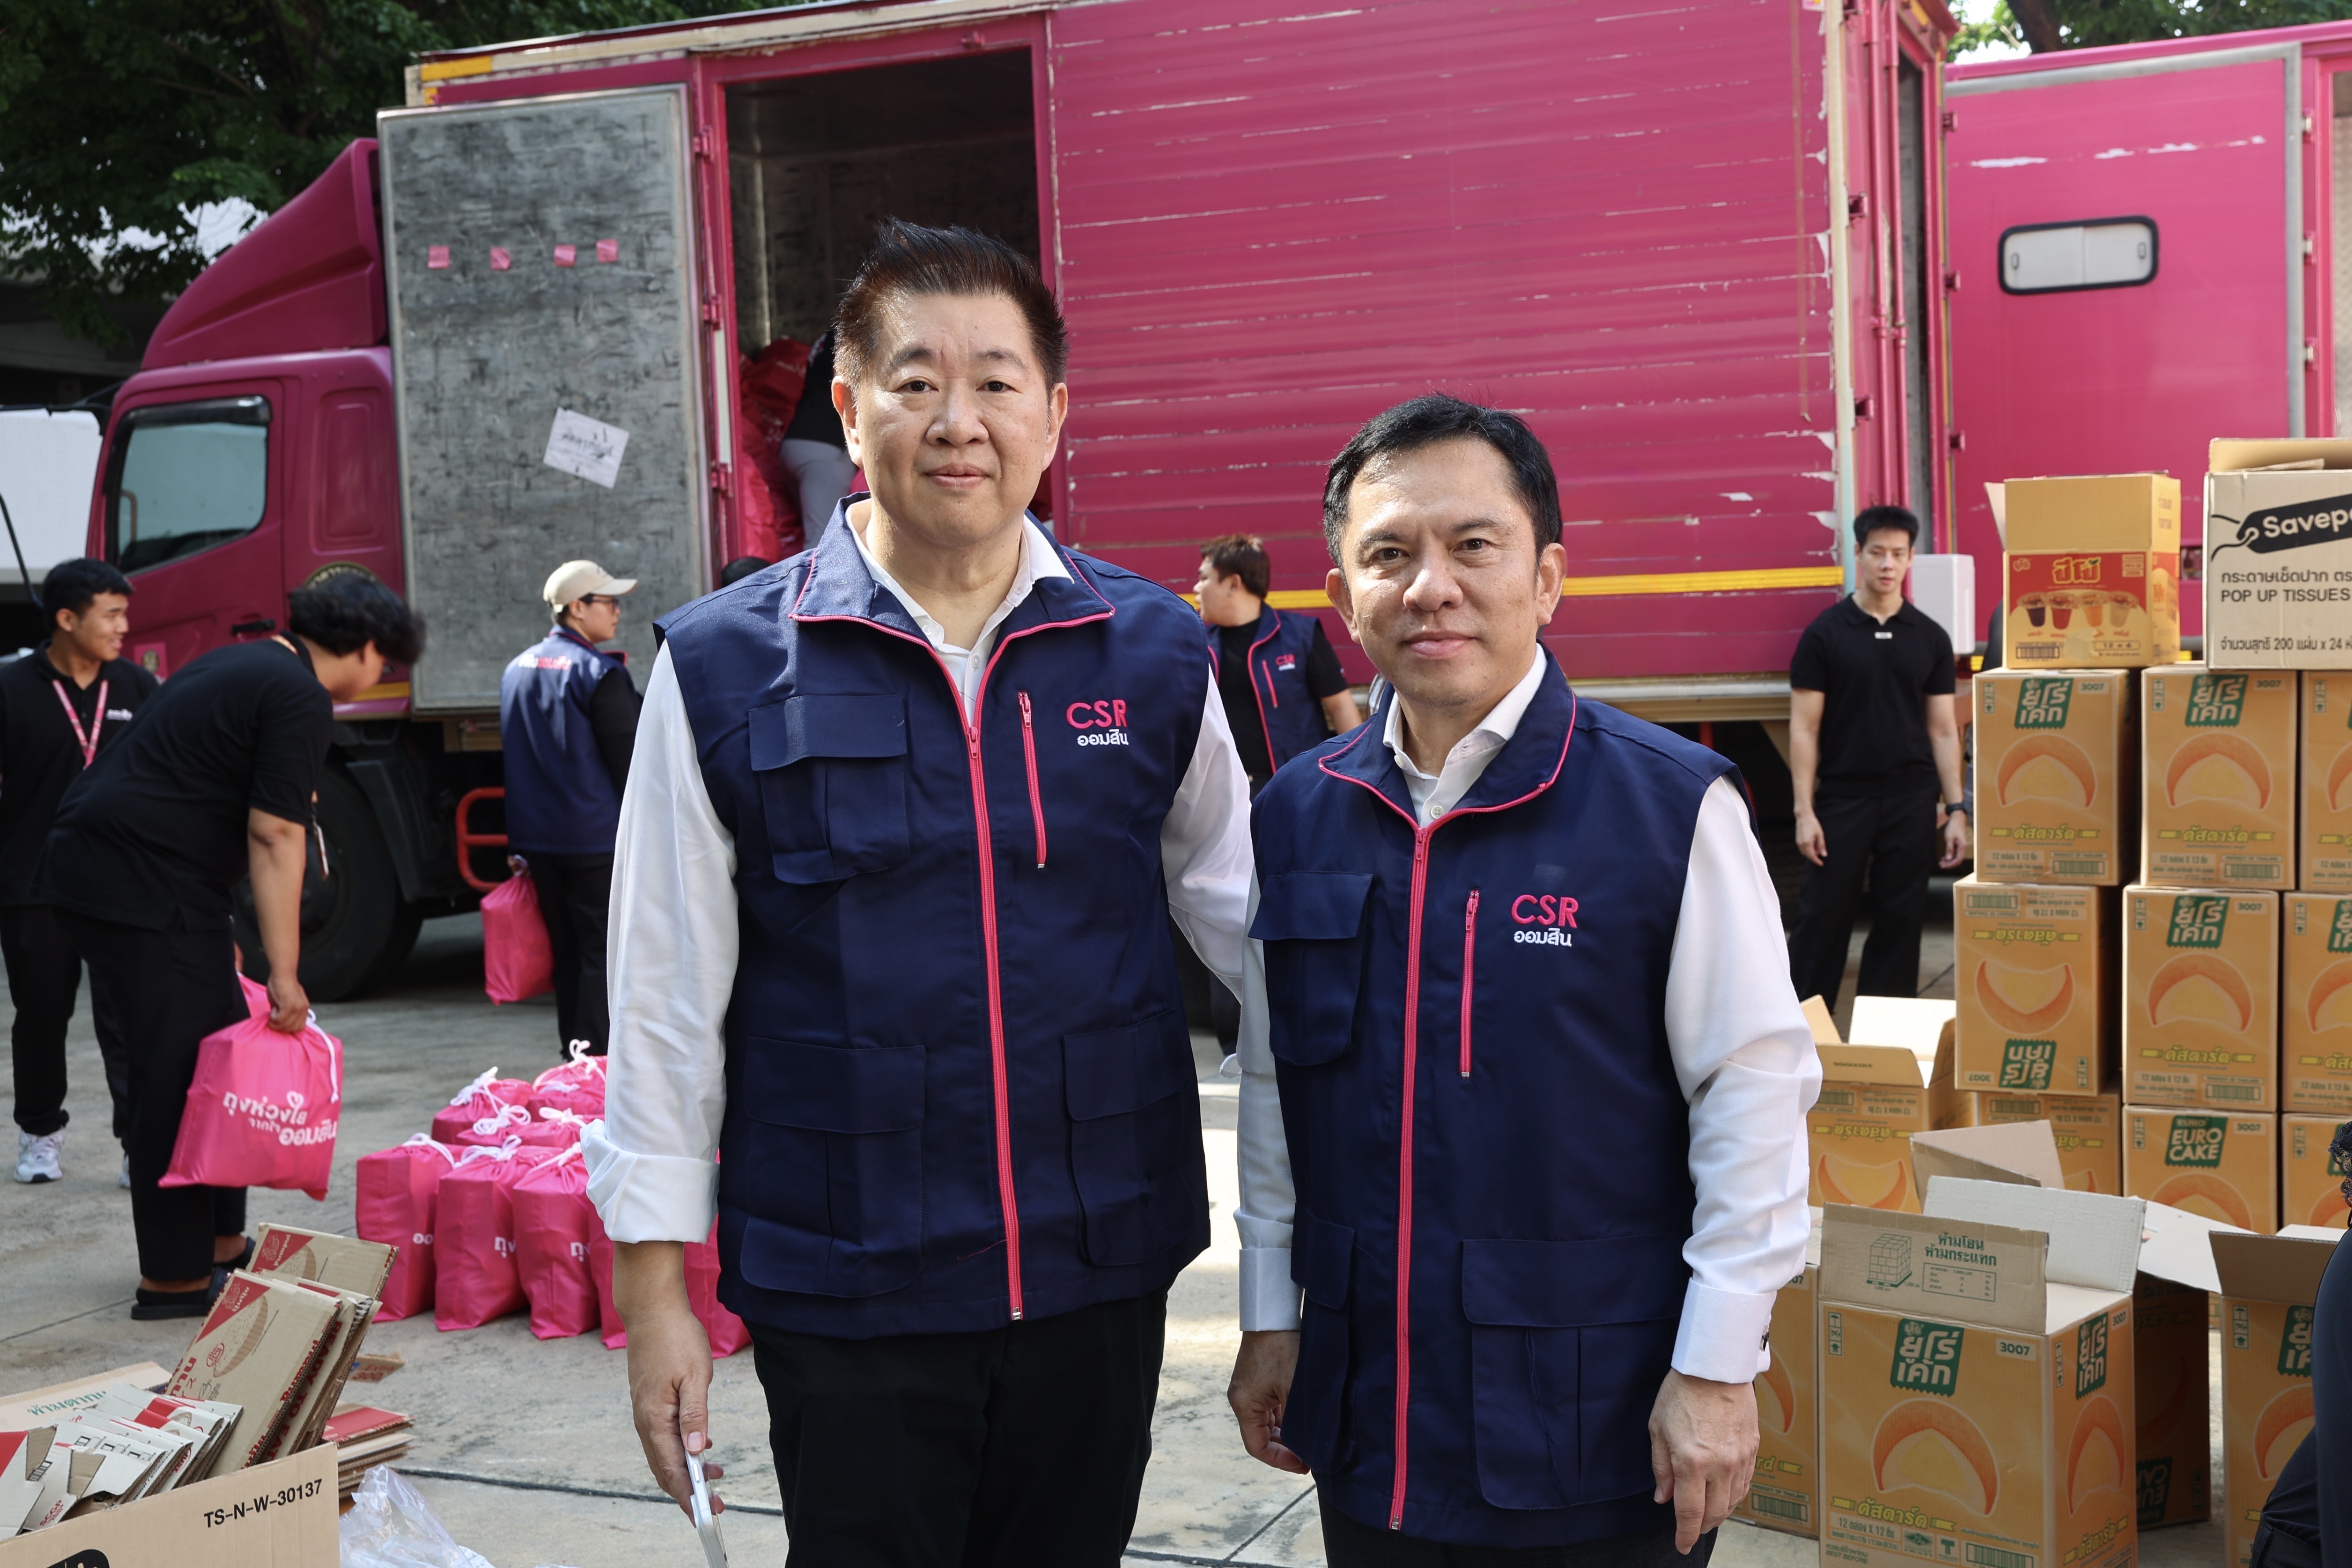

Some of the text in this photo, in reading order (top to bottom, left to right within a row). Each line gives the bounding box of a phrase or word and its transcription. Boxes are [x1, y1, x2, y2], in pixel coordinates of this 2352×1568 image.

[2262, 509, 2352, 538] Savep
[2221, 566, 2329, 583] กระดาษเช็ดปาก
[2221, 587, 2351, 602] POP UP TISSUES
[2273, 638, 2293, 650] 200
[2329, 638, 2342, 650] 24
[2081, 683, 2105, 691] 3007
[2256, 679, 2281, 688] 3007
[1065, 699, 1128, 730] CSR
[1076, 728, 1129, 747] ออมสิน
[1511, 894, 1579, 929] CSR
[2238, 902, 2263, 911] 3007
[1513, 927, 1572, 948] ออมสิน
[2171, 1127, 2223, 1145] EURO
[2236, 1123, 2262, 1132] 3007
[2168, 1143, 2220, 1162] CAKE
[1937, 1232, 1984, 1251] ห้ามโยน
[1924, 1243, 1997, 1267] ห้ามกระแทก
[2000, 1342, 2030, 1356] 3007
[267, 1321, 343, 1461] READY TO EAT
[204, 1478, 322, 1528] TS-N-W-30137
[1857, 1497, 1928, 1529] คัสตาร์ด
[1839, 1517, 1848, 1529] 12
[1876, 1525, 1885, 1537] 12
